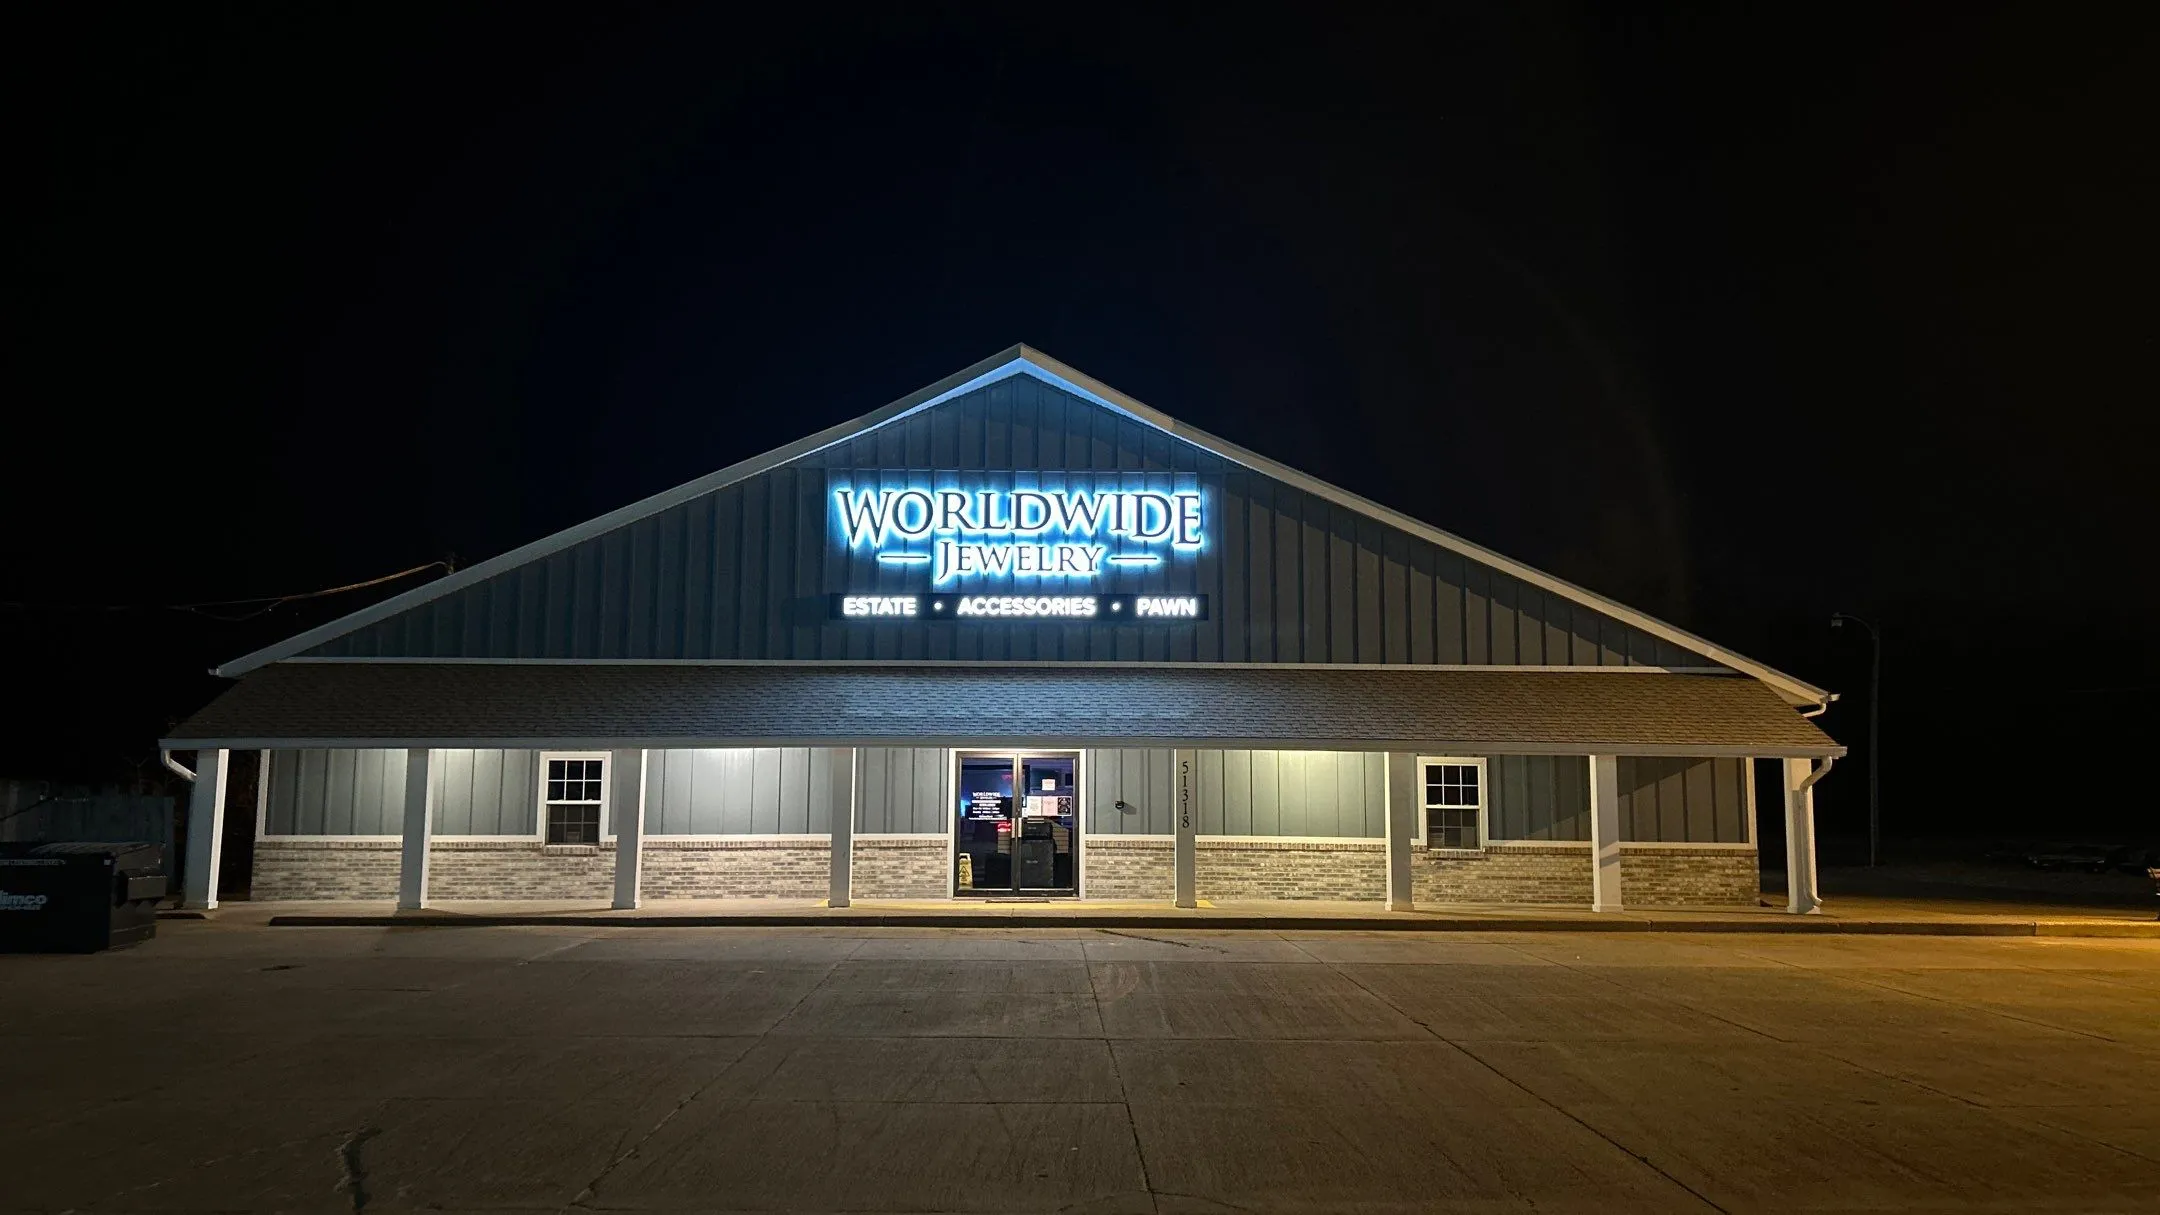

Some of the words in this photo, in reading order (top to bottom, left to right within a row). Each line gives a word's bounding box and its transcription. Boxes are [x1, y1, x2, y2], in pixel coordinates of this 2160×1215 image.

[837, 490, 1202, 545] WORLDWIDE
[938, 541, 1103, 581] JEWELRY
[843, 597, 916, 616] ESTATE
[957, 597, 1096, 616] ACCESSORIES
[1136, 597, 1197, 616] PAWN
[1182, 760, 1190, 829] 51318
